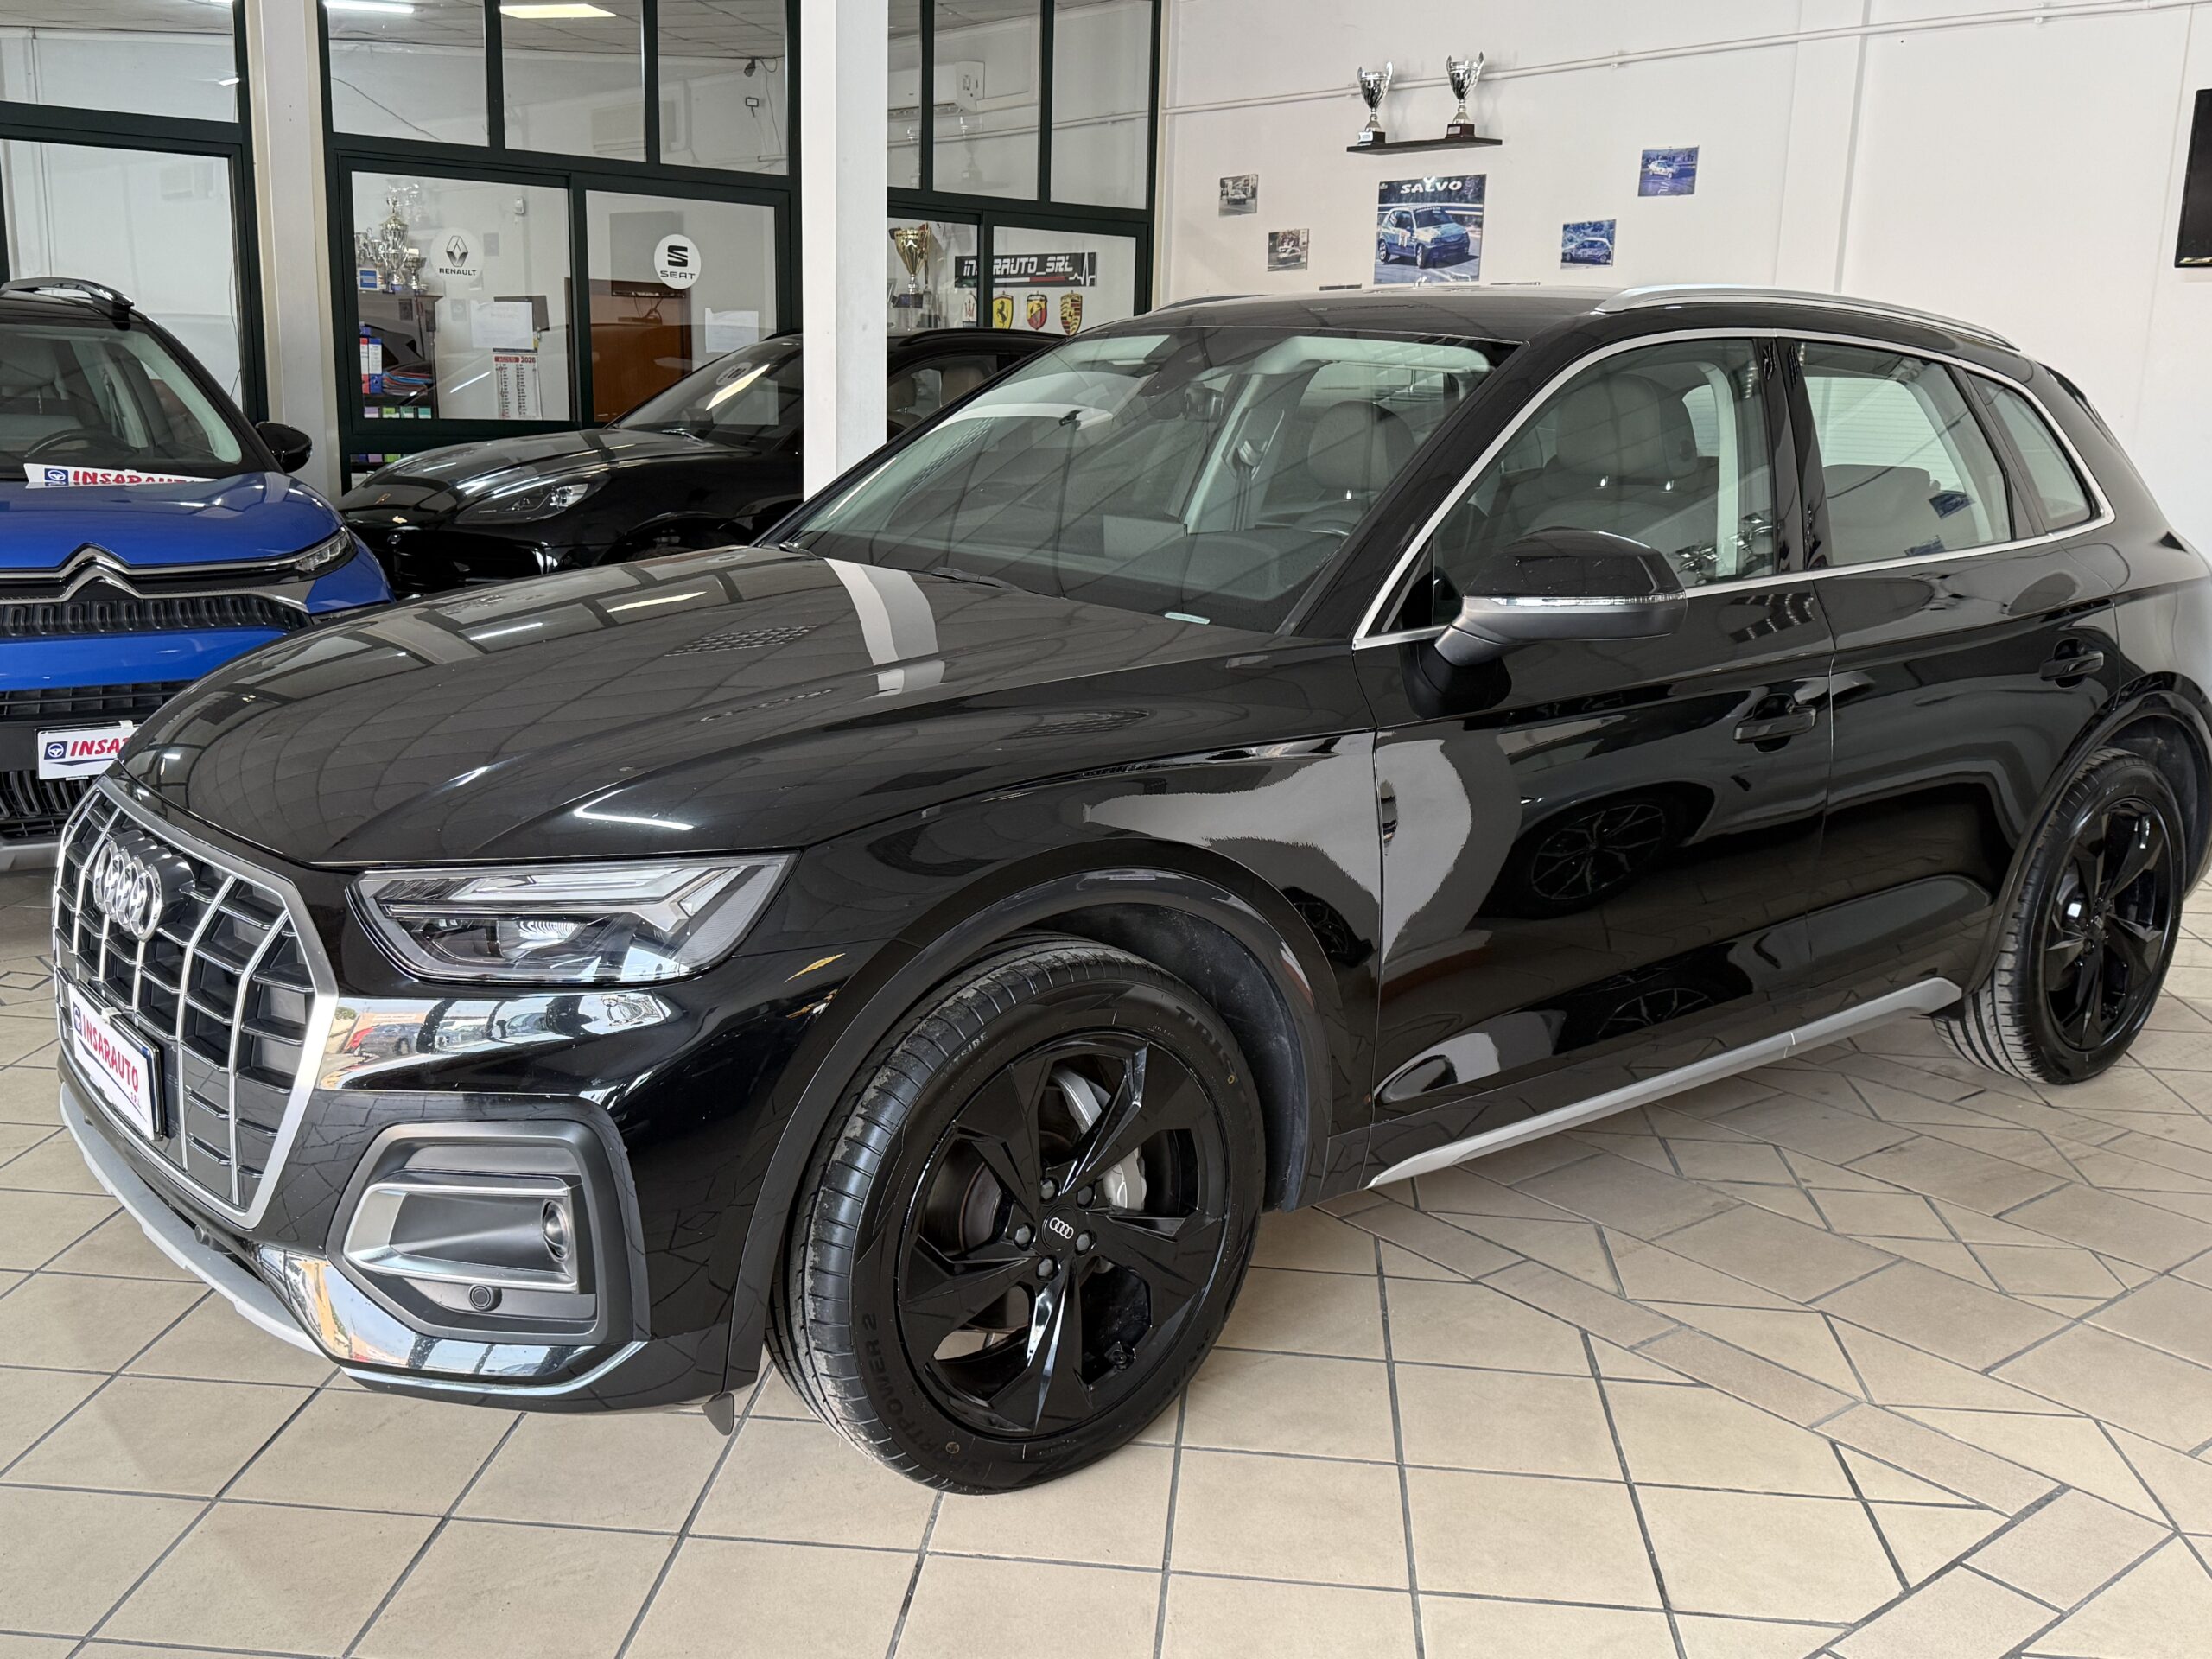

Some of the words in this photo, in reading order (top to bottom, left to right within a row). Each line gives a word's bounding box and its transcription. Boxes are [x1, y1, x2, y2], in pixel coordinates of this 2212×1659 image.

[1400, 181, 1462, 194] SALVO
[659, 270, 696, 280] SEAT
[70, 737, 129, 757] INSA
[82, 1015, 138, 1092] INSARAUTO
